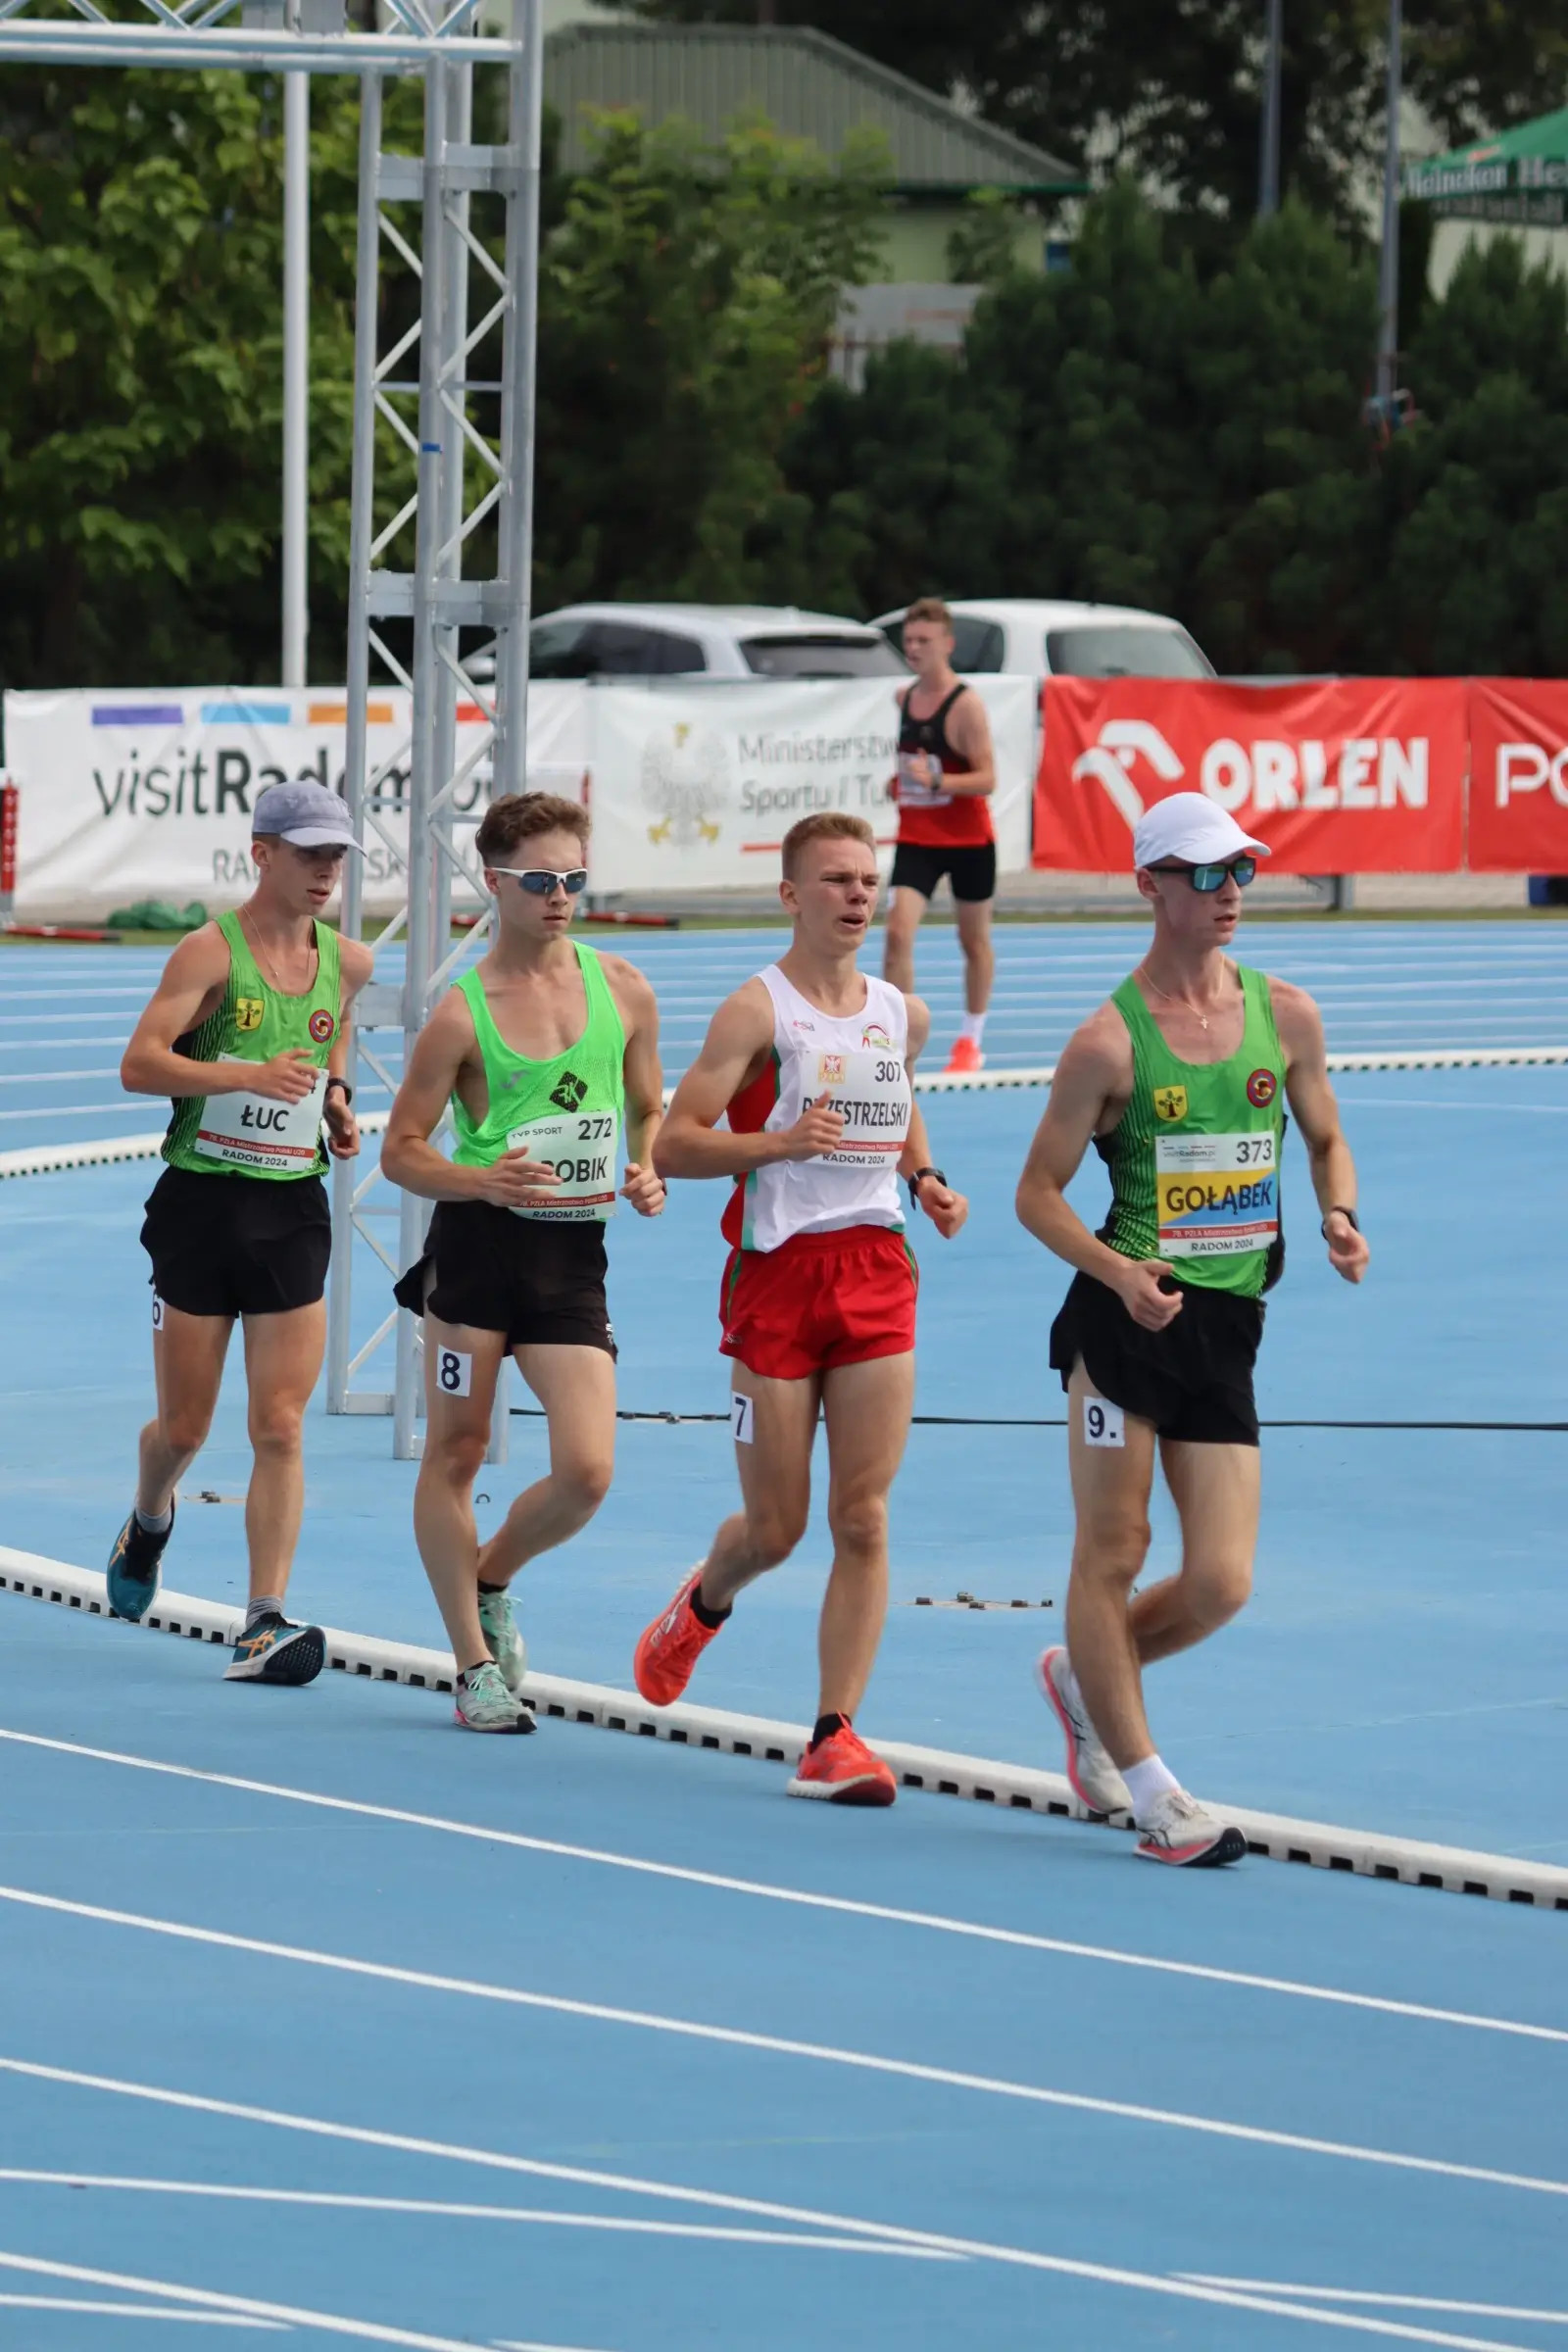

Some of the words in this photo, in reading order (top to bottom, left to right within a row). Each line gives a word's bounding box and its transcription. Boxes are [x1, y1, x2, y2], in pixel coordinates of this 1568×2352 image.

[1200, 737, 1429, 812] ORLEN
[740, 779, 832, 817] Sportu
[874, 1060, 901, 1082] 307
[240, 1104, 289, 1132] ŁUC
[577, 1116, 612, 1141] 272
[511, 1130, 530, 1140] TVP
[532, 1126, 563, 1136] SPORT
[221, 1149, 263, 1164] RADOM
[265, 1156, 288, 1167] 2024
[822, 1153, 865, 1164] RADOM
[867, 1155, 885, 1164] 2024
[1236, 1139, 1272, 1163] 373
[541, 1155, 609, 1184] OBIK
[1165, 1180, 1273, 1215] GOŁĄBEK
[532, 1210, 573, 1219] RADOM
[575, 1208, 596, 1218] 2024
[1191, 1242, 1233, 1252] RADOM
[1235, 1238, 1253, 1249] 2024
[441, 1352, 461, 1390] 8
[735, 1396, 747, 1437] 7
[1088, 1405, 1116, 1439] 9.
